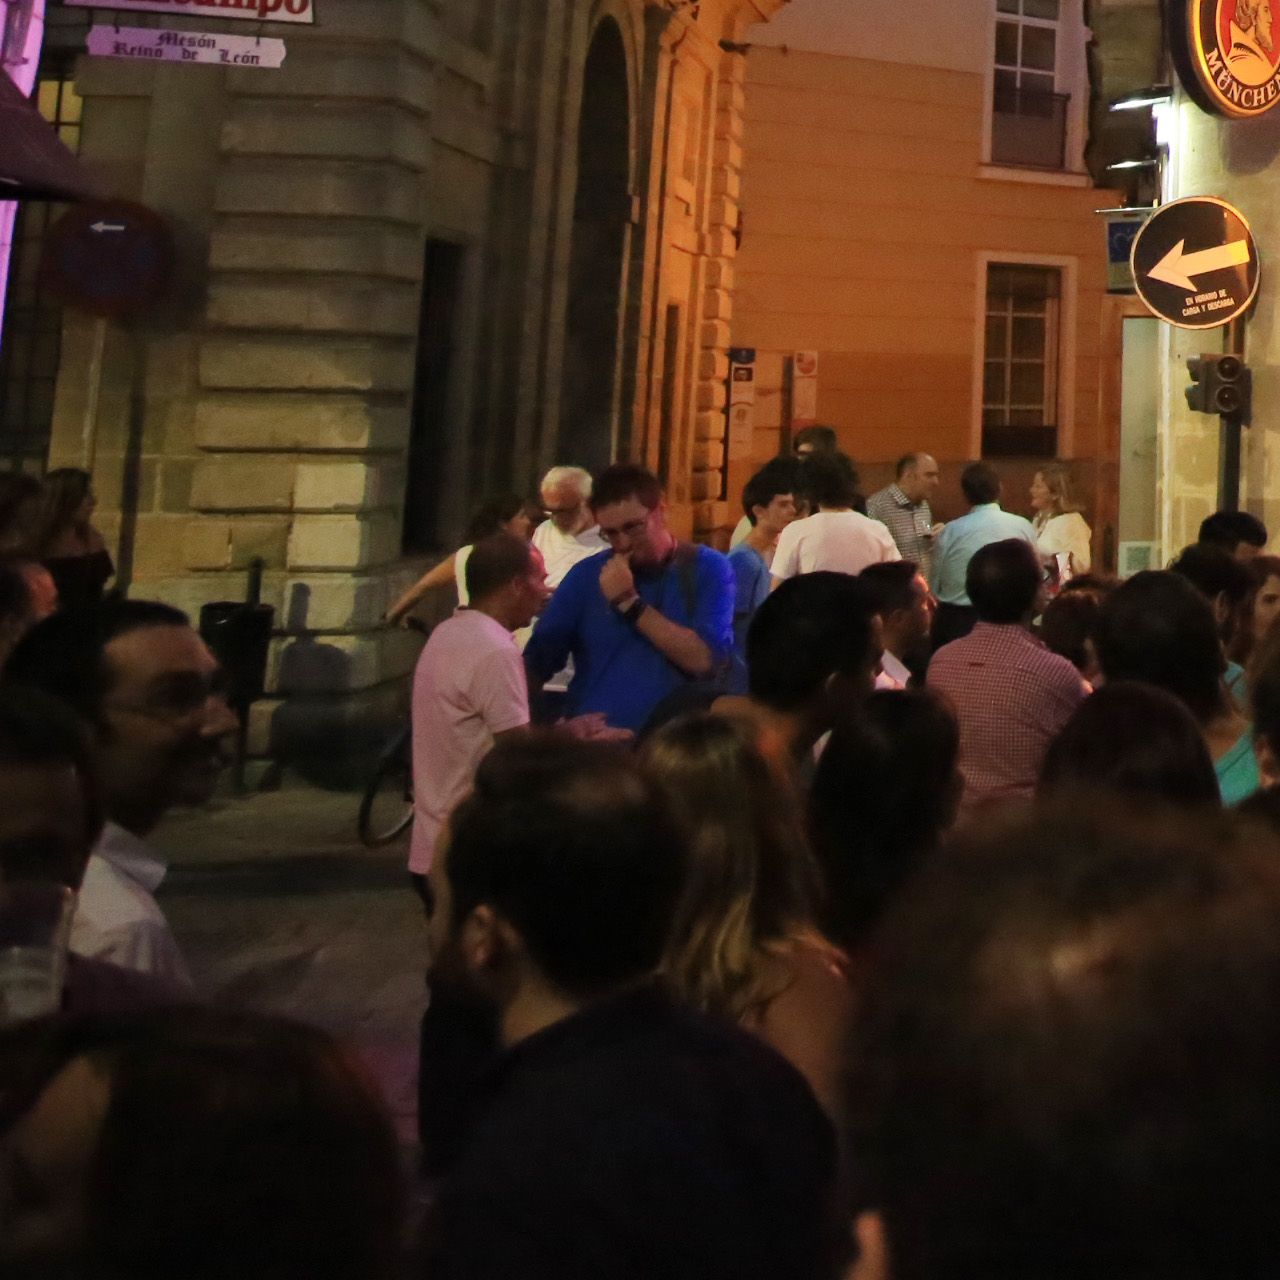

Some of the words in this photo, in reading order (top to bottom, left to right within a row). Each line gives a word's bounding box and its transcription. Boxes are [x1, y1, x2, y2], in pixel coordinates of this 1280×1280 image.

[155, 31, 217, 48] Mesón
[112, 41, 163, 58] Reino
[181, 47, 199, 61] de
[218, 48, 260, 65] León
[1182, 306, 1200, 317] CARGA
[1207, 297, 1235, 311] DESCARGA
